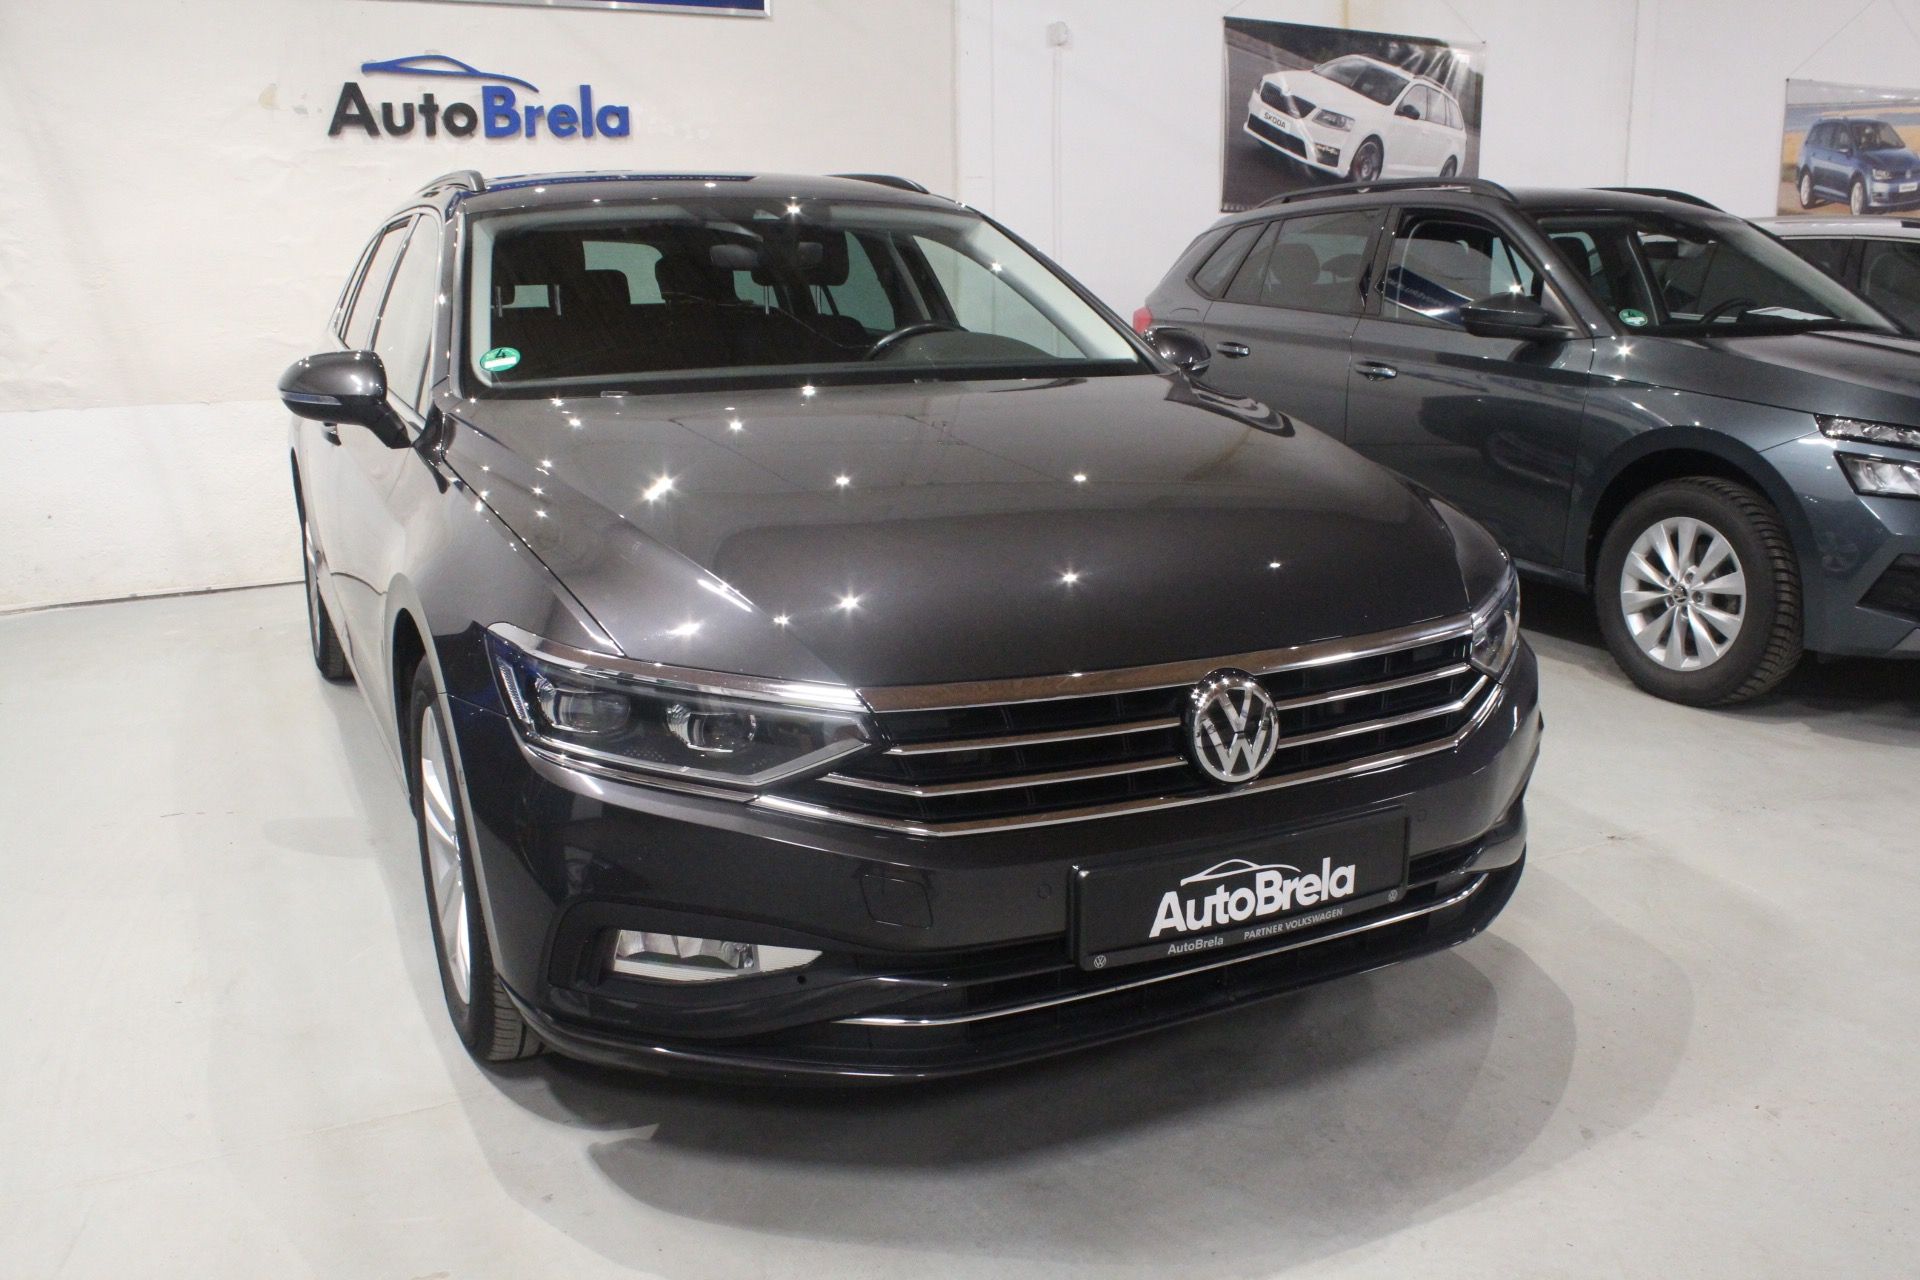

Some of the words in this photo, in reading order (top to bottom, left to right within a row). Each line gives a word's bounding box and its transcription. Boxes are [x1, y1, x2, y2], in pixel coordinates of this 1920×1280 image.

[328, 82, 630, 138] AutoBrela
[1149, 857, 1356, 938] AutoBrela
[1168, 936, 1224, 955] AutoBrela
[1244, 924, 1283, 940] PARTNER
[1285, 908, 1344, 930] VOLKSWAGEN
